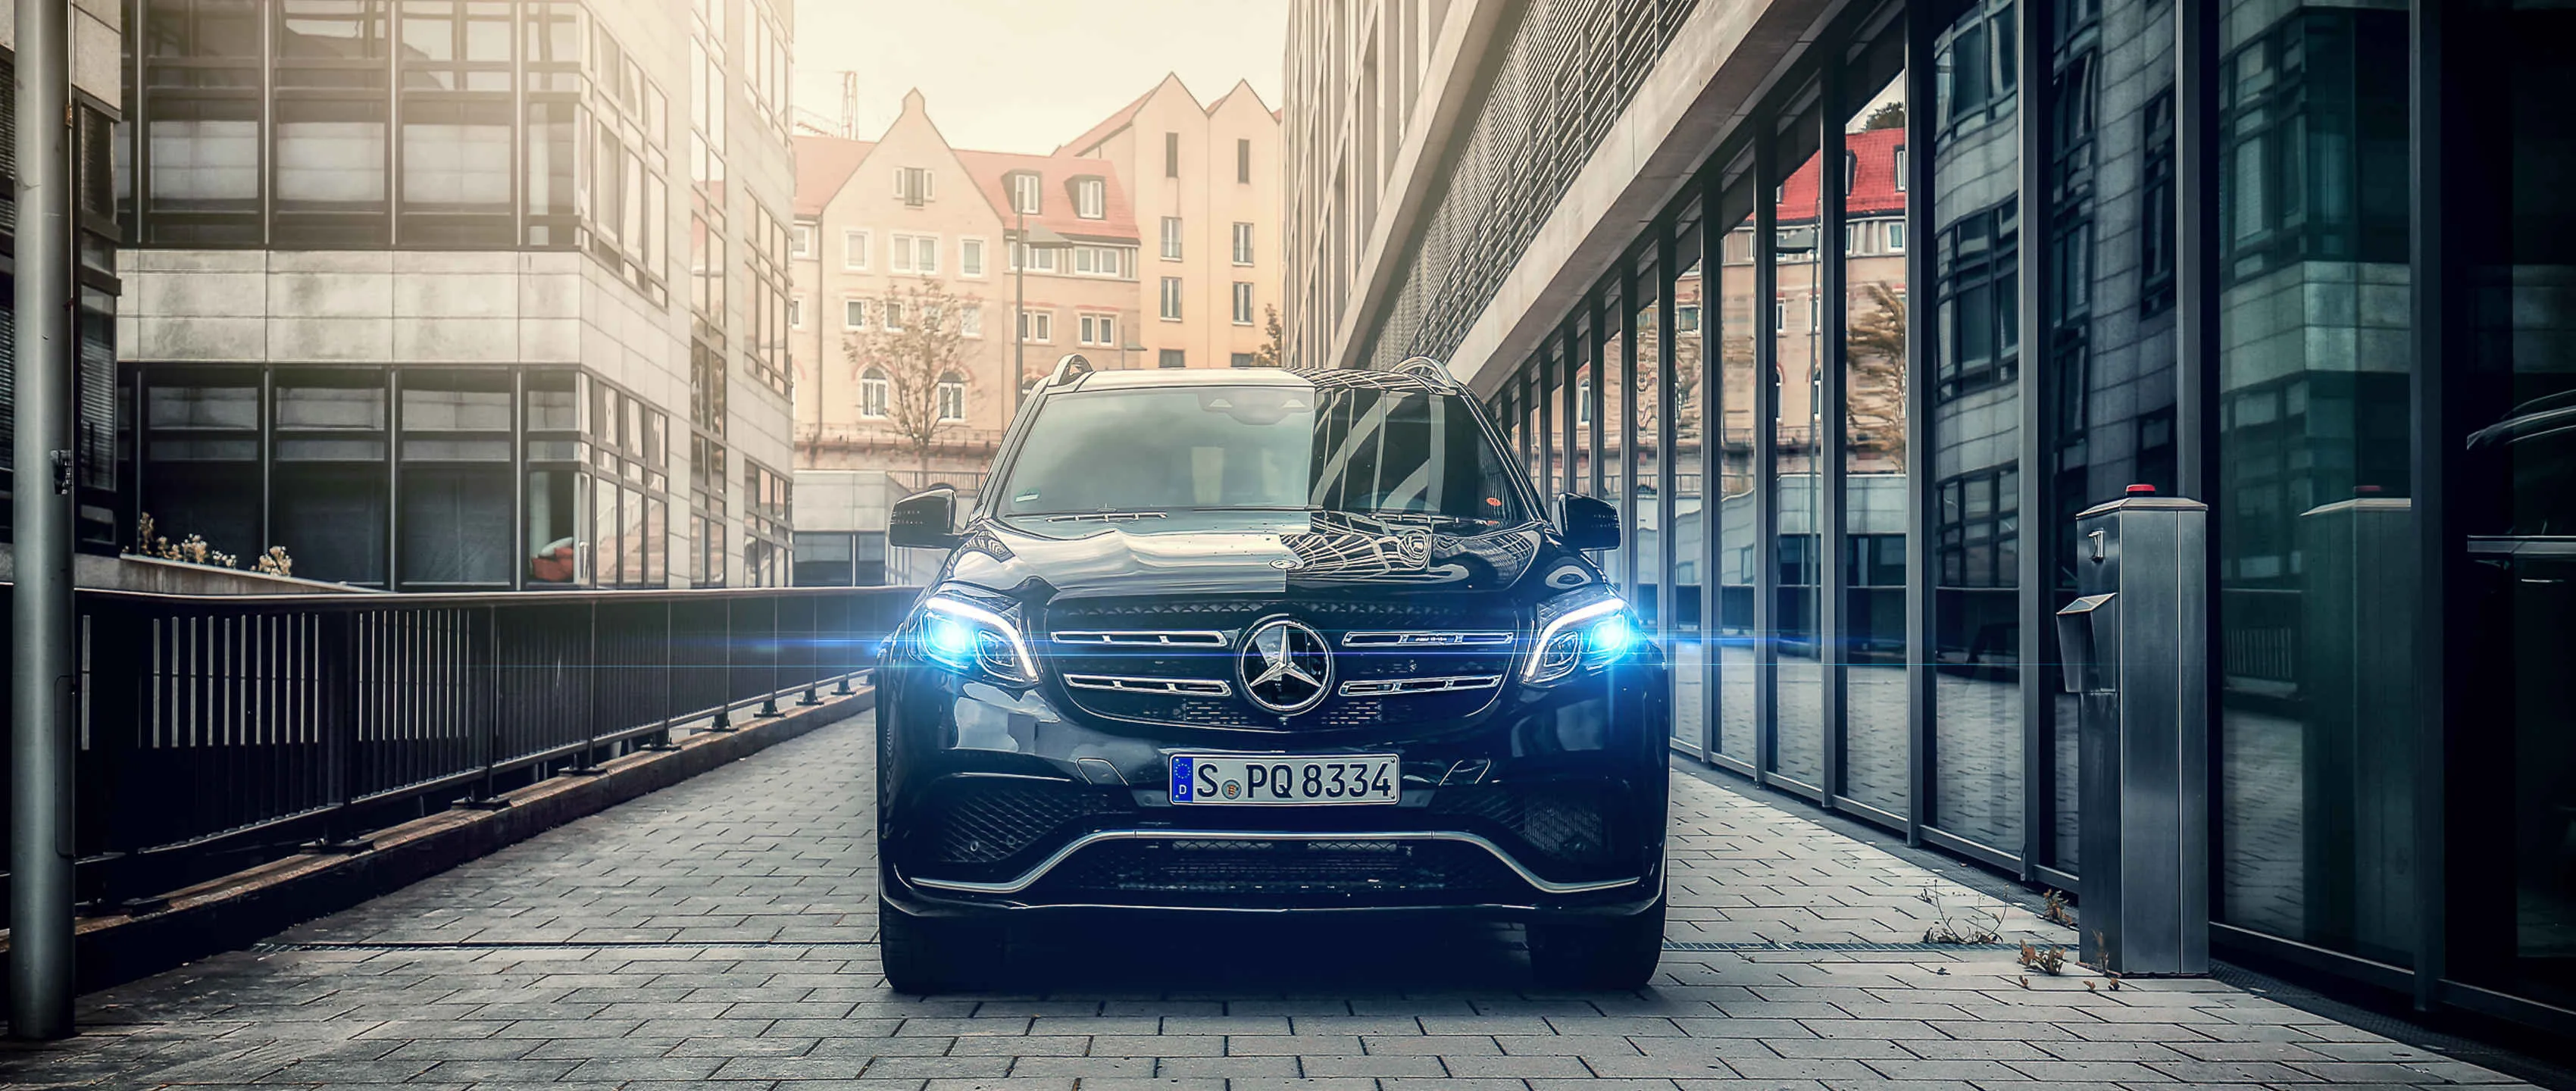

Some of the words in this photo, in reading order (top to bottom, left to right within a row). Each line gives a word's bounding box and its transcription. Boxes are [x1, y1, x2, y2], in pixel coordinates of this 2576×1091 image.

[1179, 784, 1187, 795] D
[1196, 764, 1218, 798] S
[1246, 764, 1293, 799] PQ
[1302, 763, 1391, 798] 8334
